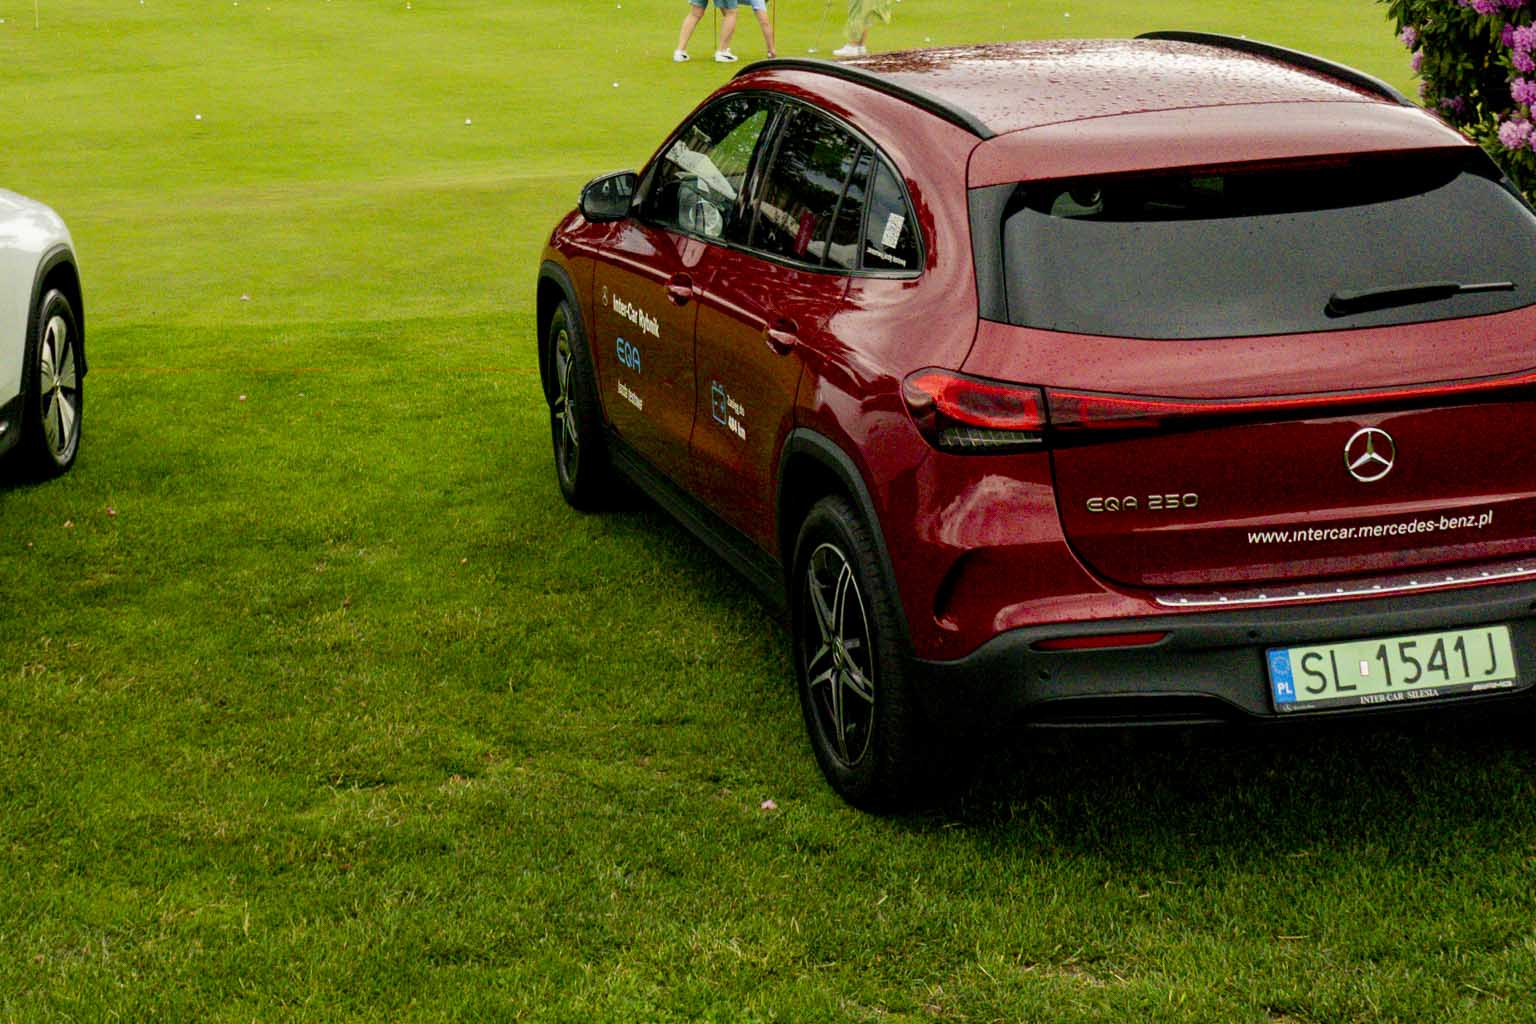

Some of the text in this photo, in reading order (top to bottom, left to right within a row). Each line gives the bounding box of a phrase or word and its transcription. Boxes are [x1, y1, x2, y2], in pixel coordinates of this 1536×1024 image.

[616, 337, 641, 374] EQA
[1086, 493, 1199, 512] EQA 250
[1247, 510, 1494, 544] www.intercar.mercedes-benz.pl
[1301, 632, 1498, 694] SL 1541J
[1277, 682, 1293, 695] PL
